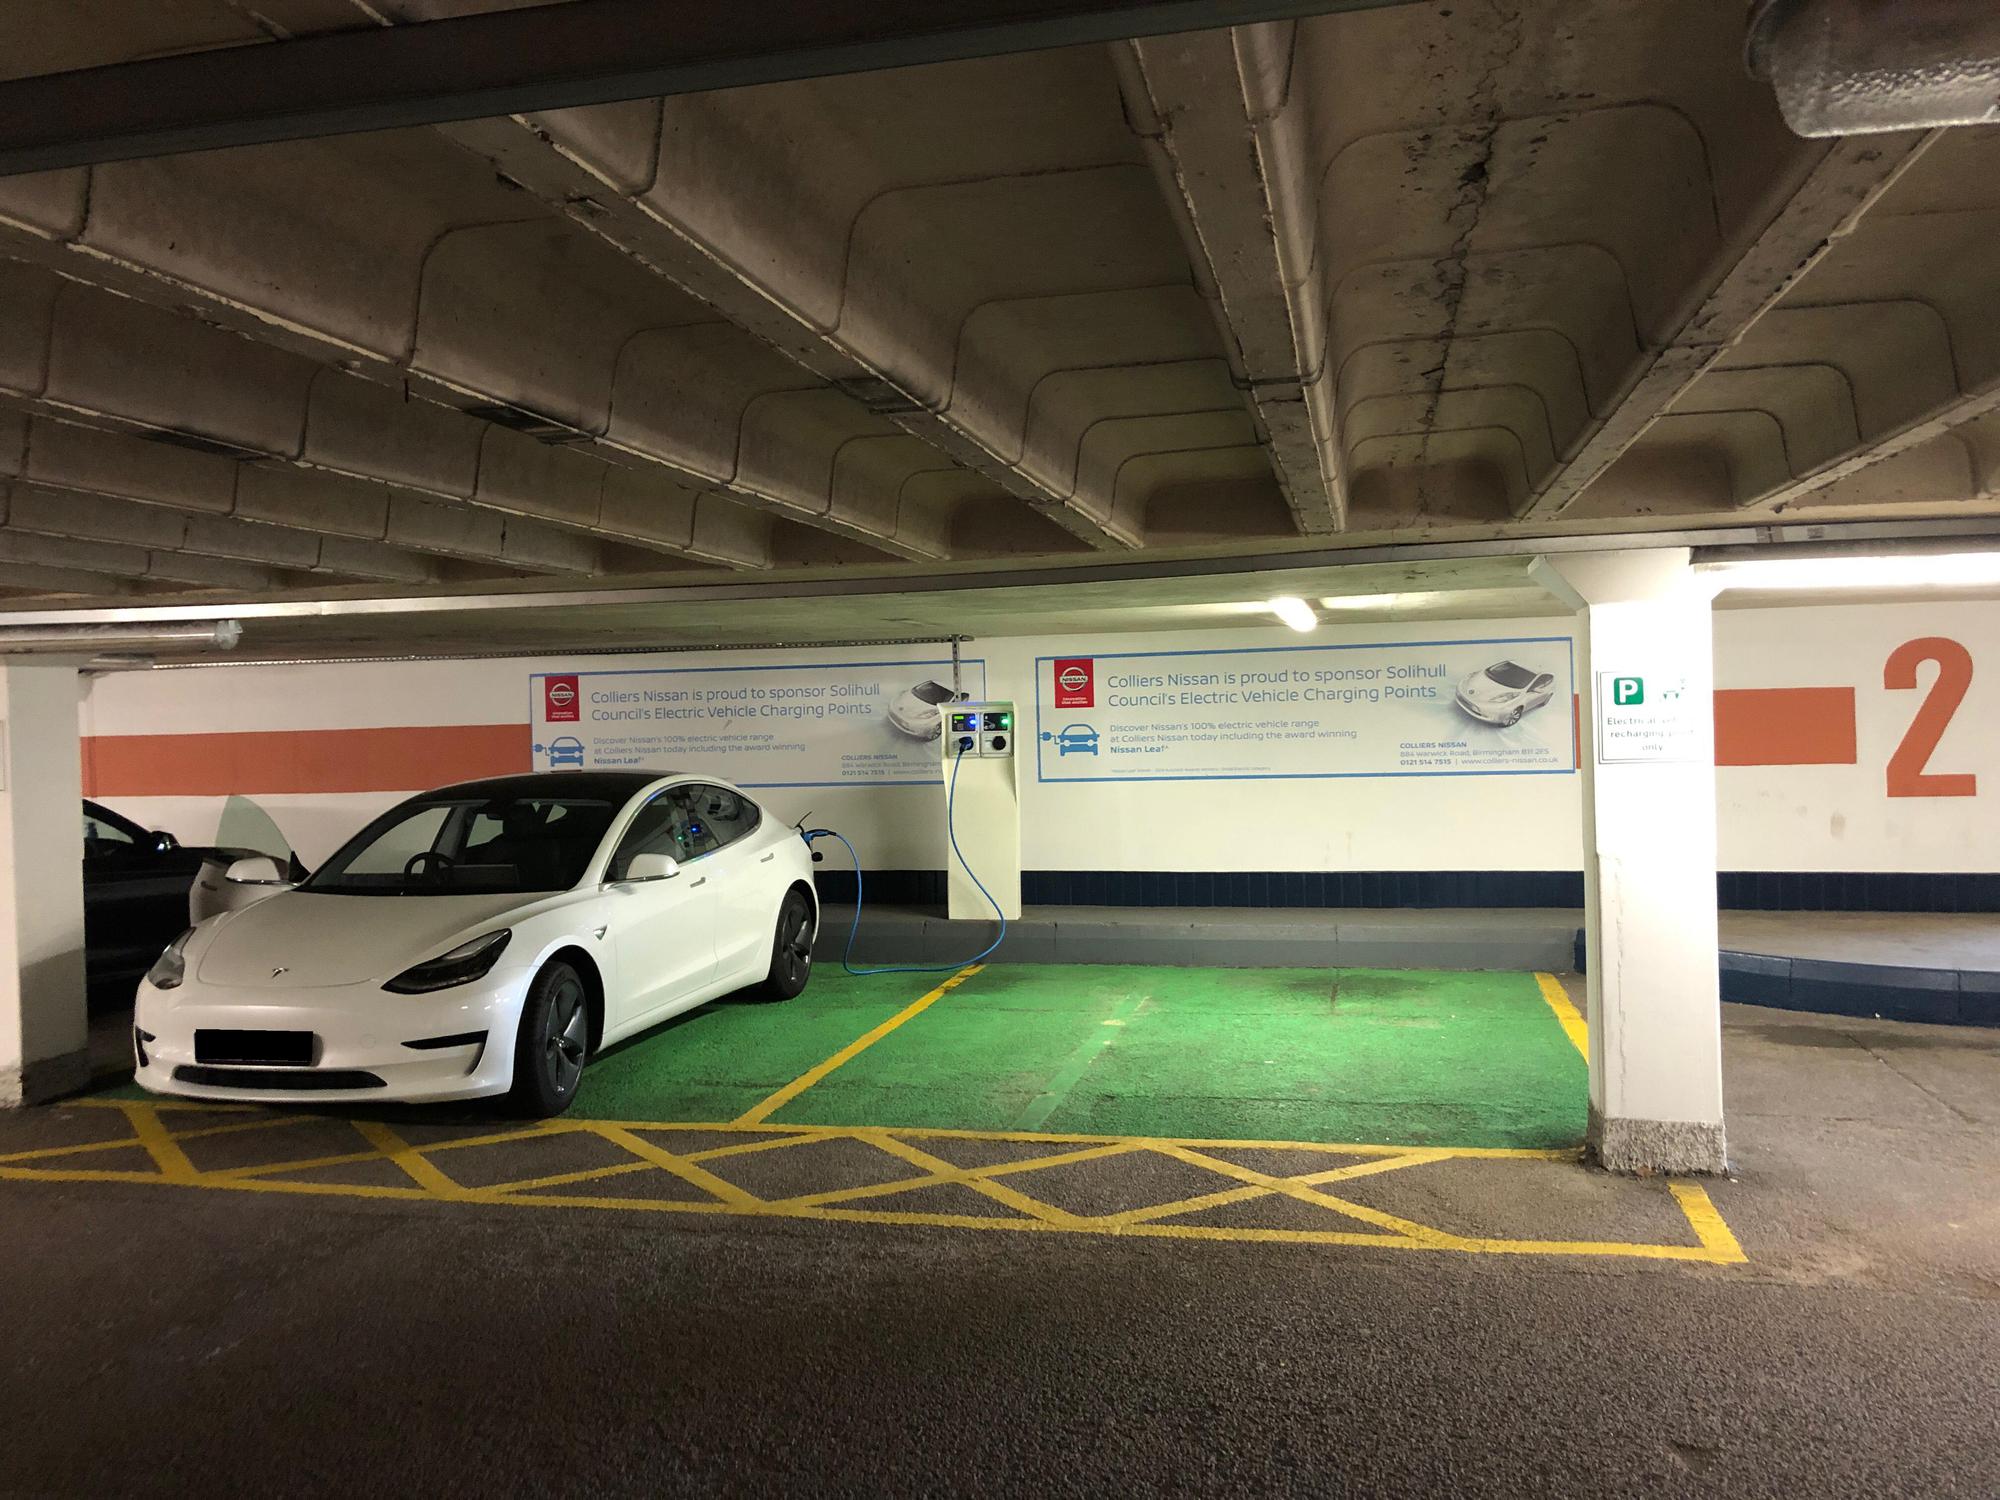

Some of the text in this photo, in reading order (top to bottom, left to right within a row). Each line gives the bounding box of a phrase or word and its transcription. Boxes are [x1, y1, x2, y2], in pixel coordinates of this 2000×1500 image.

[1107, 664, 1446, 688] Colliers Nissan is proud to sponsor Solihull
[591, 683, 880, 704] Colliers Nissan is proud to sponsor Solihull
[1108, 685, 1437, 706] Council's Electric Vehicle Charging Points
[1619, 680, 1638, 703] P
[591, 702, 872, 720] Council's Electric Vehicle Charging Points
[1884, 637, 1976, 797] 2
[1110, 720, 1319, 732] Discover Nissan's 100% electric vehicle range
[593, 734, 774, 744] Discover Nissan's 100% electric vehicle range
[1110, 729, 1357, 743] at Colliers Nissan today including the award winning
[635, 746, 661, 754] Nissan
[663, 745, 686, 754] today
[688, 744, 727, 754] including
[728, 744, 742, 752] the
[744, 743, 771, 752] award
[773, 743, 806, 752] winning
[1110, 745, 1142, 754] Nissan
[1473, 749, 1520, 757] Birmingham
[1641, 743, 1664, 752] only
[594, 757, 622, 765] Nissan
